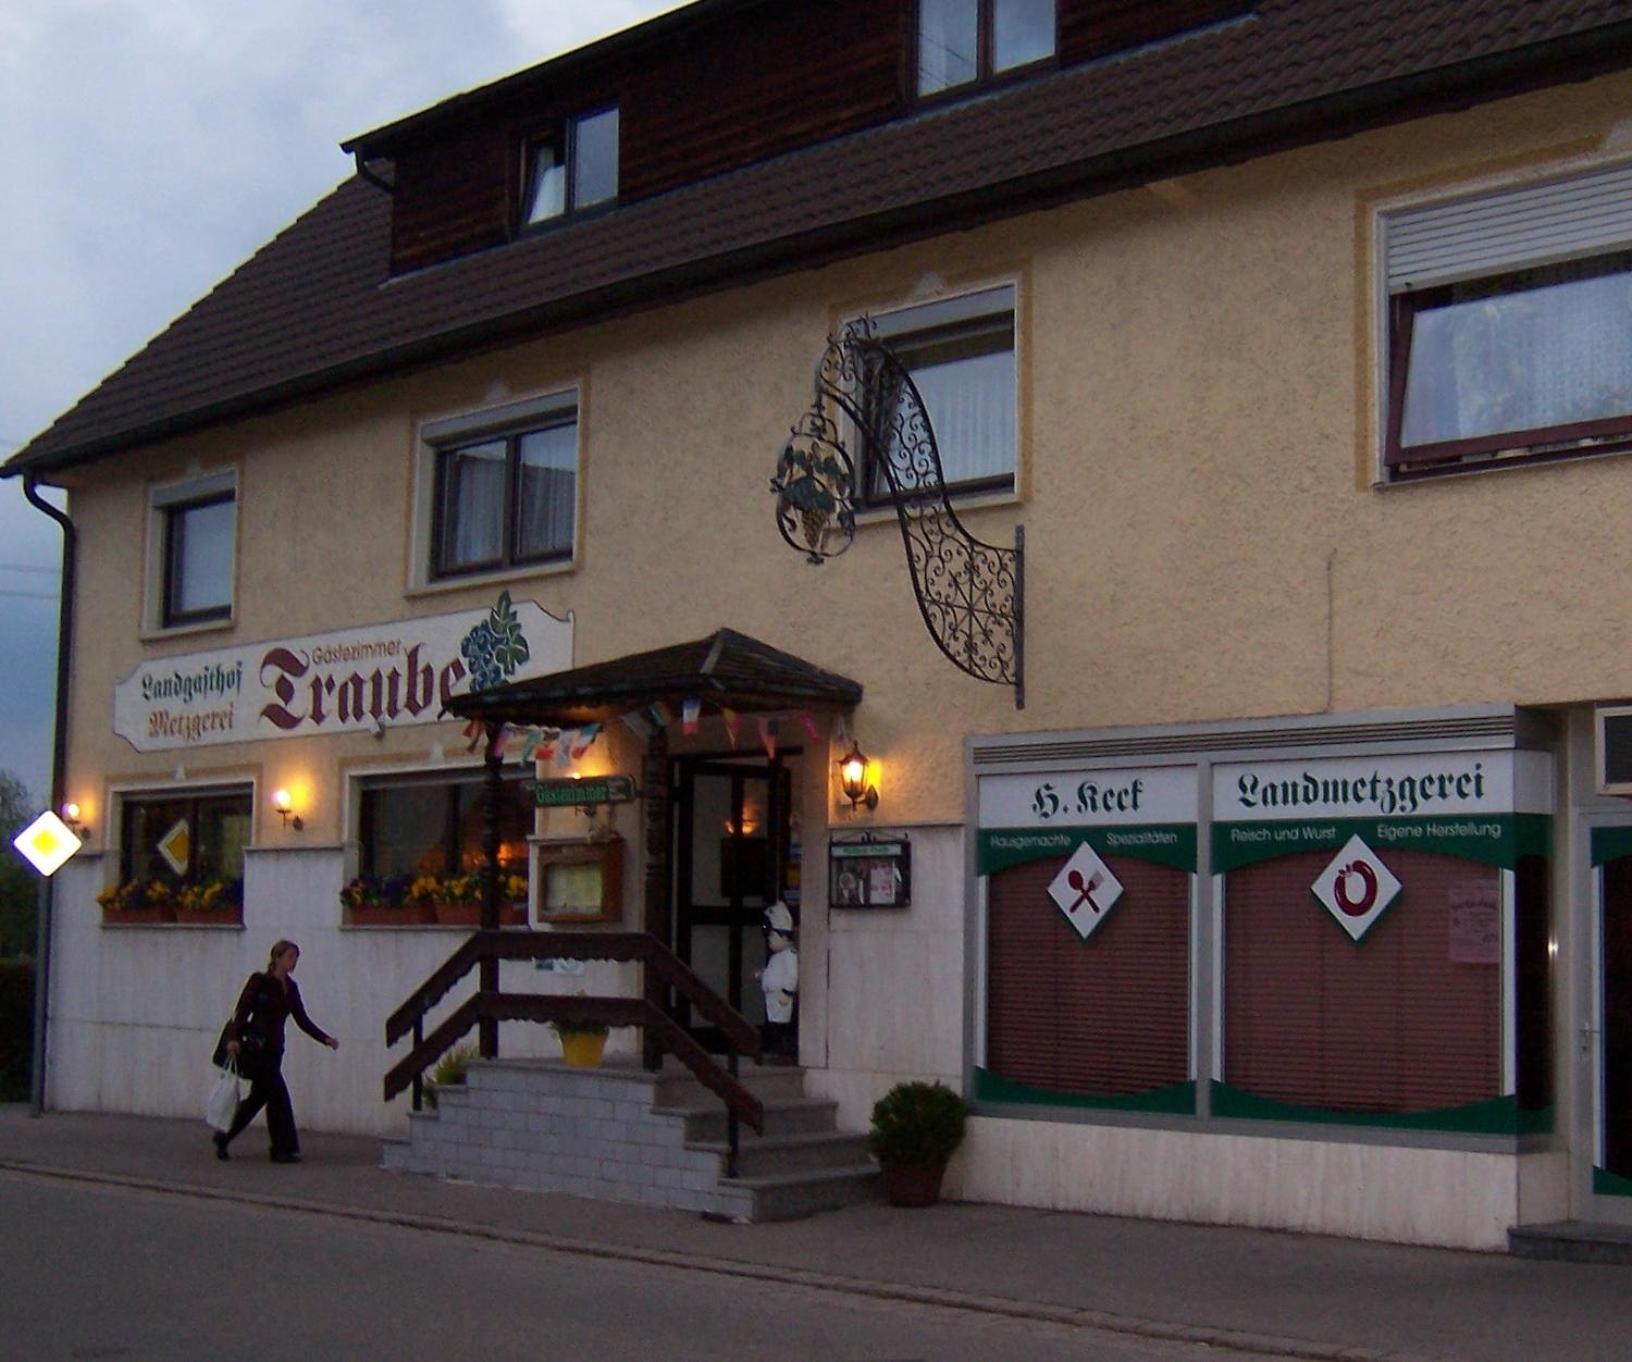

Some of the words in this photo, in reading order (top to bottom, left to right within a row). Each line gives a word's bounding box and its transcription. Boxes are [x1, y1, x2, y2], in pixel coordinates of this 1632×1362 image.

[259, 643, 467, 729] Traube
[149, 701, 234, 740] Metzgerei
[1238, 763, 1484, 813] Landmetzgerei
[1274, 827, 1299, 840] und
[1302, 826, 1336, 839] Wurst
[1376, 824, 1422, 840] Eigene
[1426, 822, 1501, 839] Herstellung
